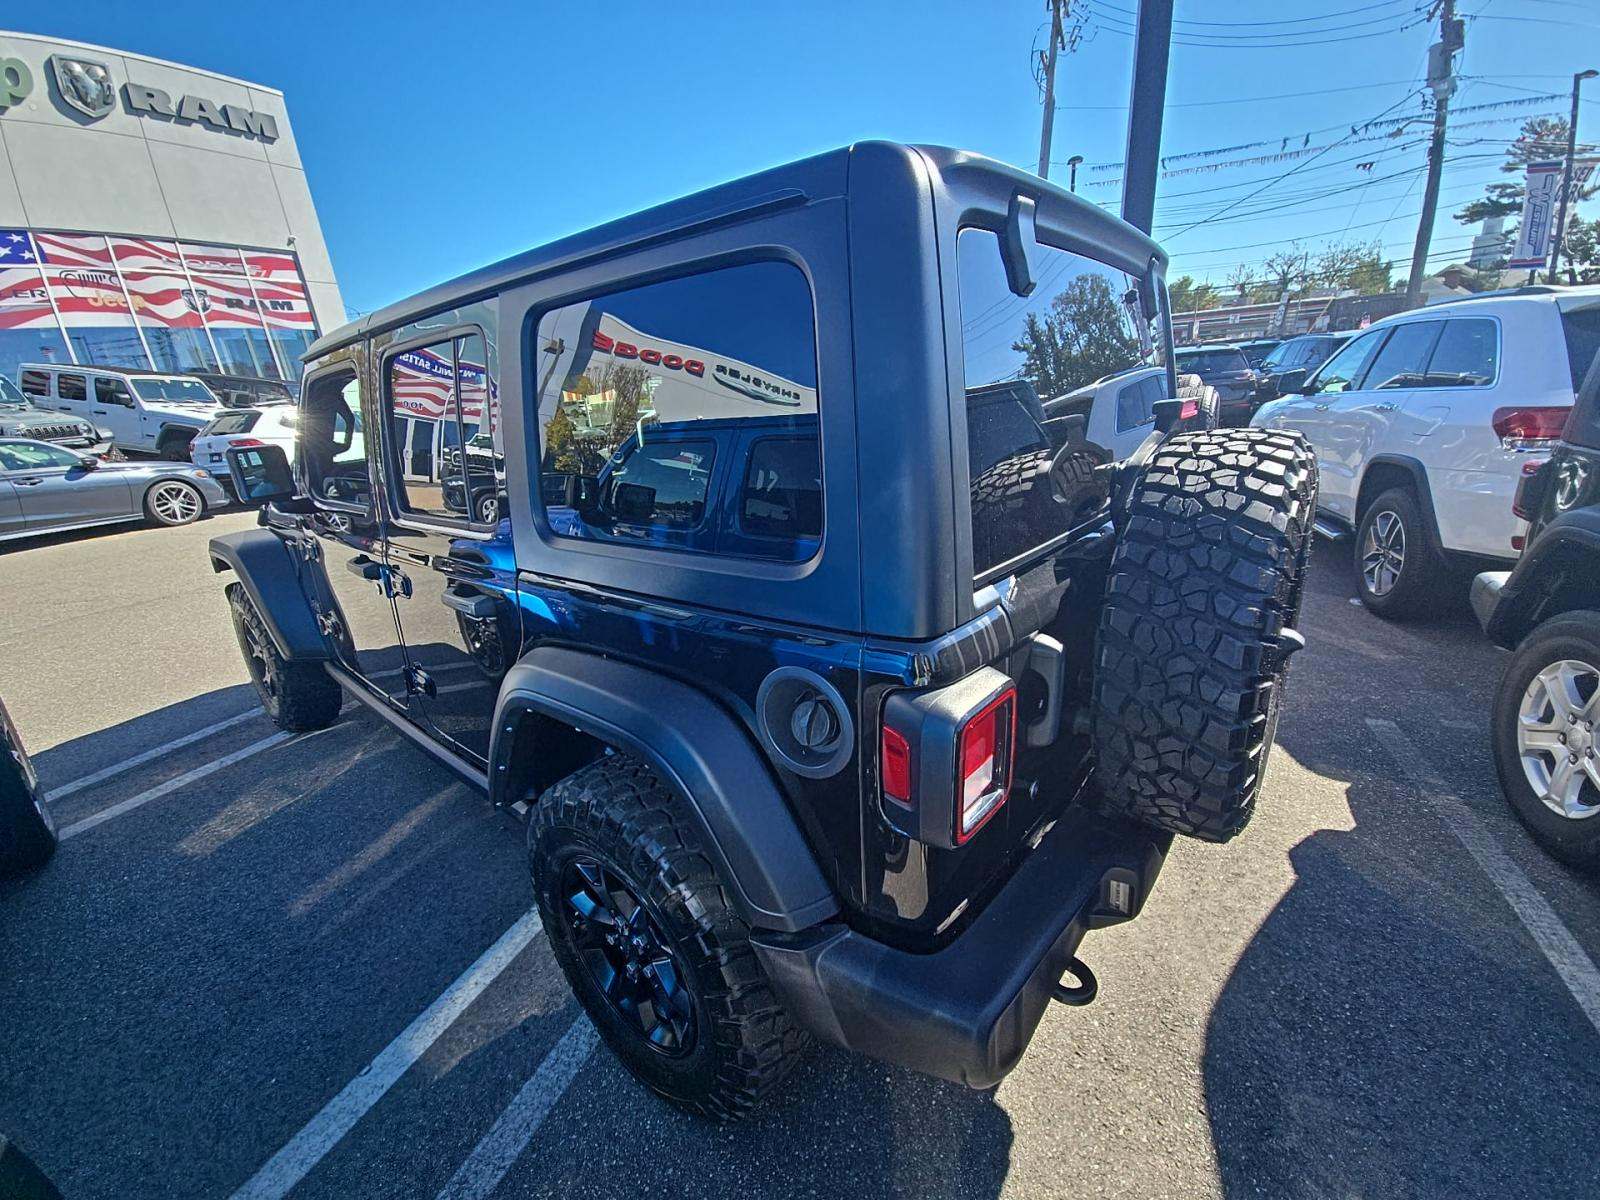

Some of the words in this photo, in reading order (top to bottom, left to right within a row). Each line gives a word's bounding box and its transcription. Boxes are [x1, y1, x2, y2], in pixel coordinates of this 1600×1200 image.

[122, 83, 280, 142] RAM
[87, 289, 145, 311] Jeep
[225, 298, 294, 311] RAM
